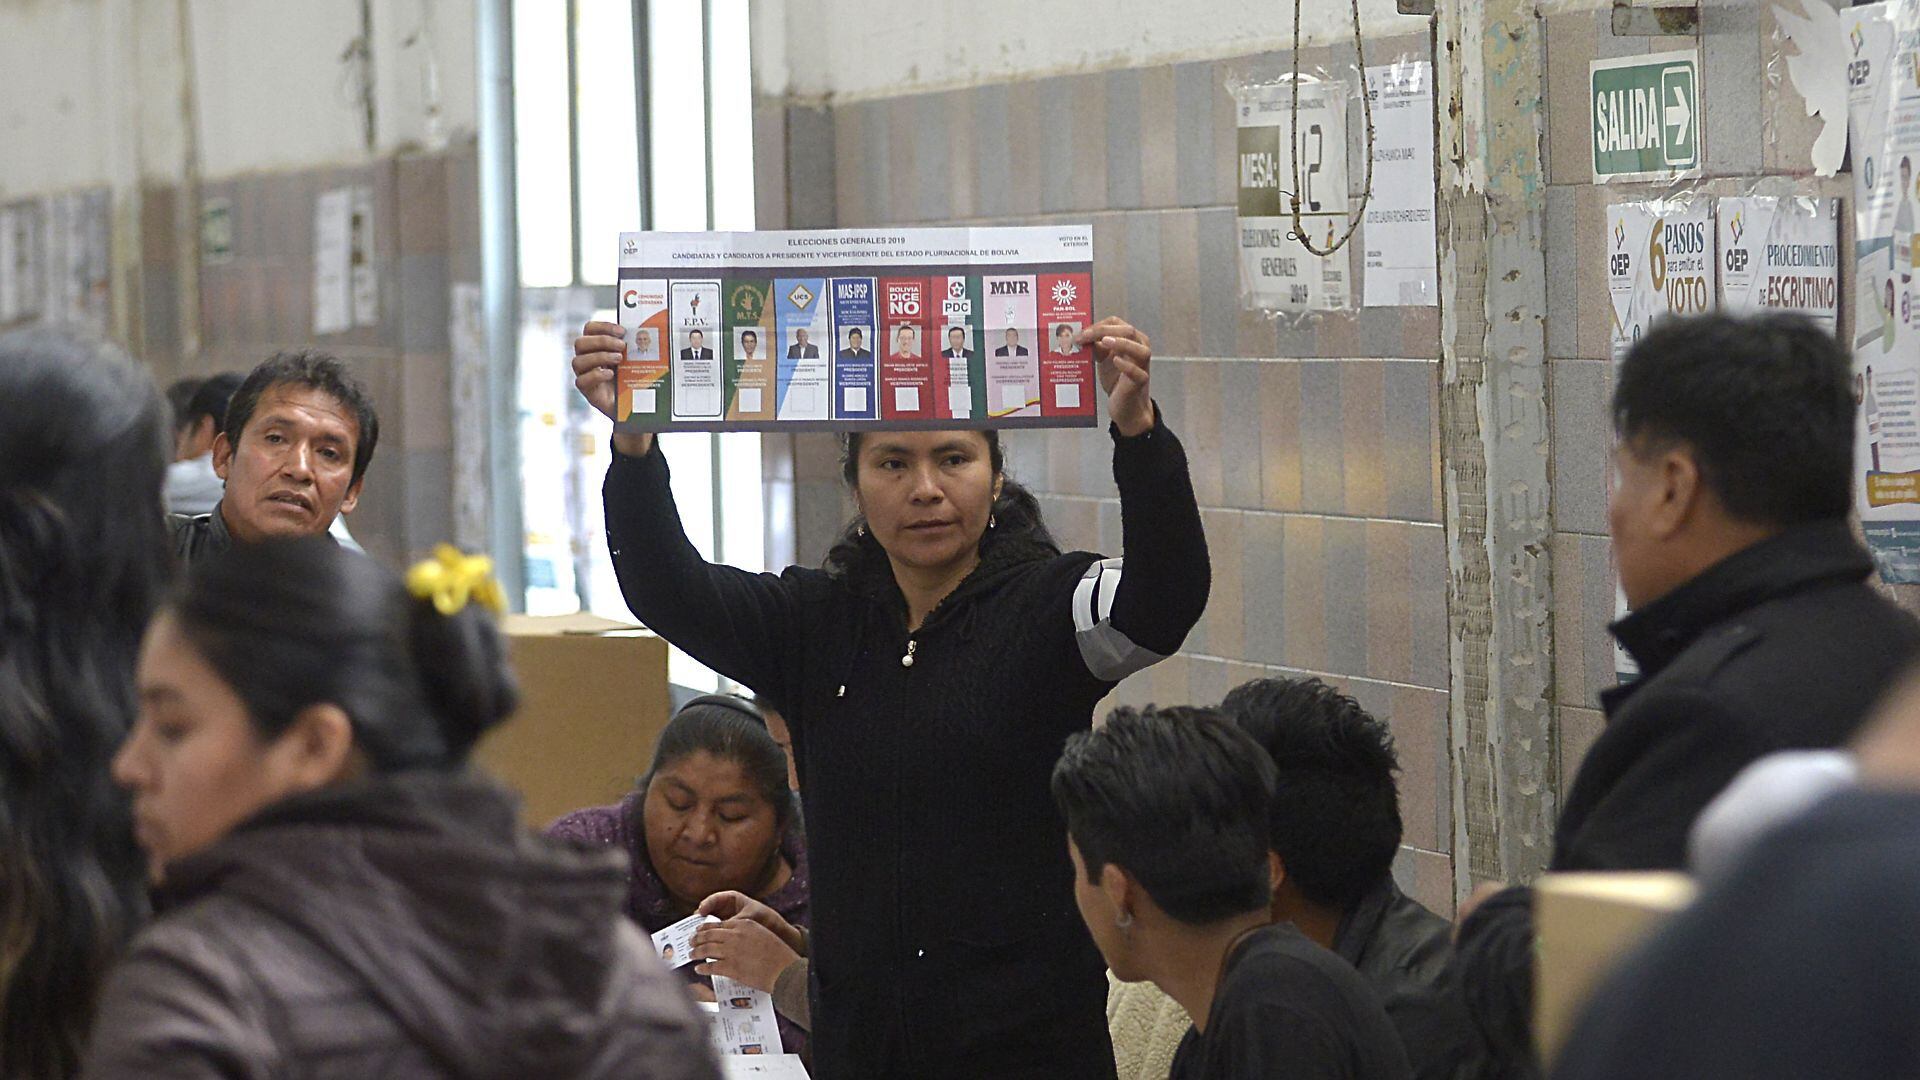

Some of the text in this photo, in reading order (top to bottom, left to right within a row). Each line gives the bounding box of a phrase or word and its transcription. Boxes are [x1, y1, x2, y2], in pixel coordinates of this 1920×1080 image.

[1597, 87, 1660, 153] SALIDA
[1240, 124, 1323, 212] MESA: 12
[787, 236, 906, 246] ELECCIONES GENERALES 2019
[672, 252, 715, 260] CANDIDATAS
[723, 252, 764, 260] CANDIDATOS
[772, 251, 815, 259] PRESIDENTE
[816, 251, 821, 259] Y
[822, 250, 878, 259] VICEPRESIDENTE
[925, 249, 978, 257] PLURINACIONAL
[1611, 253, 1630, 276] OEP
[1649, 218, 1705, 292] 6 PASOS
[1726, 248, 1749, 272] OEP
[1767, 244, 1836, 267] PROCEDIMIENTO
[838, 284, 868, 300] MAS-IPSP
[889, 293, 920, 301] DICE
[990, 281, 1030, 295] MNR
[1665, 276, 1707, 315] VOTO
[1767, 276, 1835, 309] ESCRUTINIO
[890, 301, 920, 315] NO
[945, 302, 969, 312] PDC
